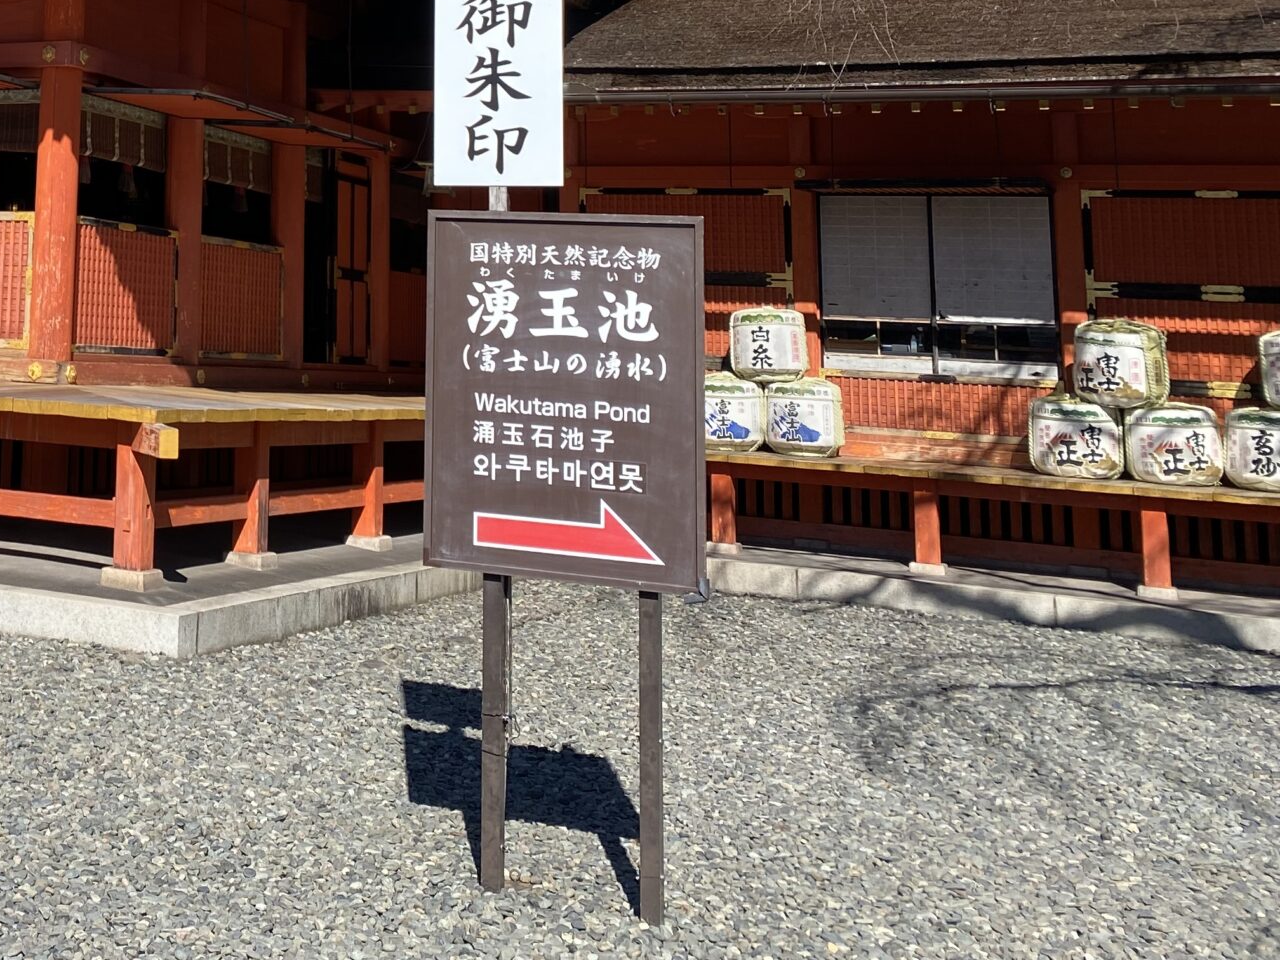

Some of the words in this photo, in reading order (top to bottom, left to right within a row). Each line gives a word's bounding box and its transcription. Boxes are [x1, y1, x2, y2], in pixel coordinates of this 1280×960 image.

[470, 242, 661, 270] 国特別天然記念物
[466, 279, 659, 343] 湧玉池
[751, 326, 773, 369] 白糸
[474, 392, 587, 419] Wakutama
[594, 401, 650, 424] Pond
[715, 399, 733, 439] 富士山
[785, 401, 801, 442] 富士山
[473, 420, 615, 453] 涌玉石池子
